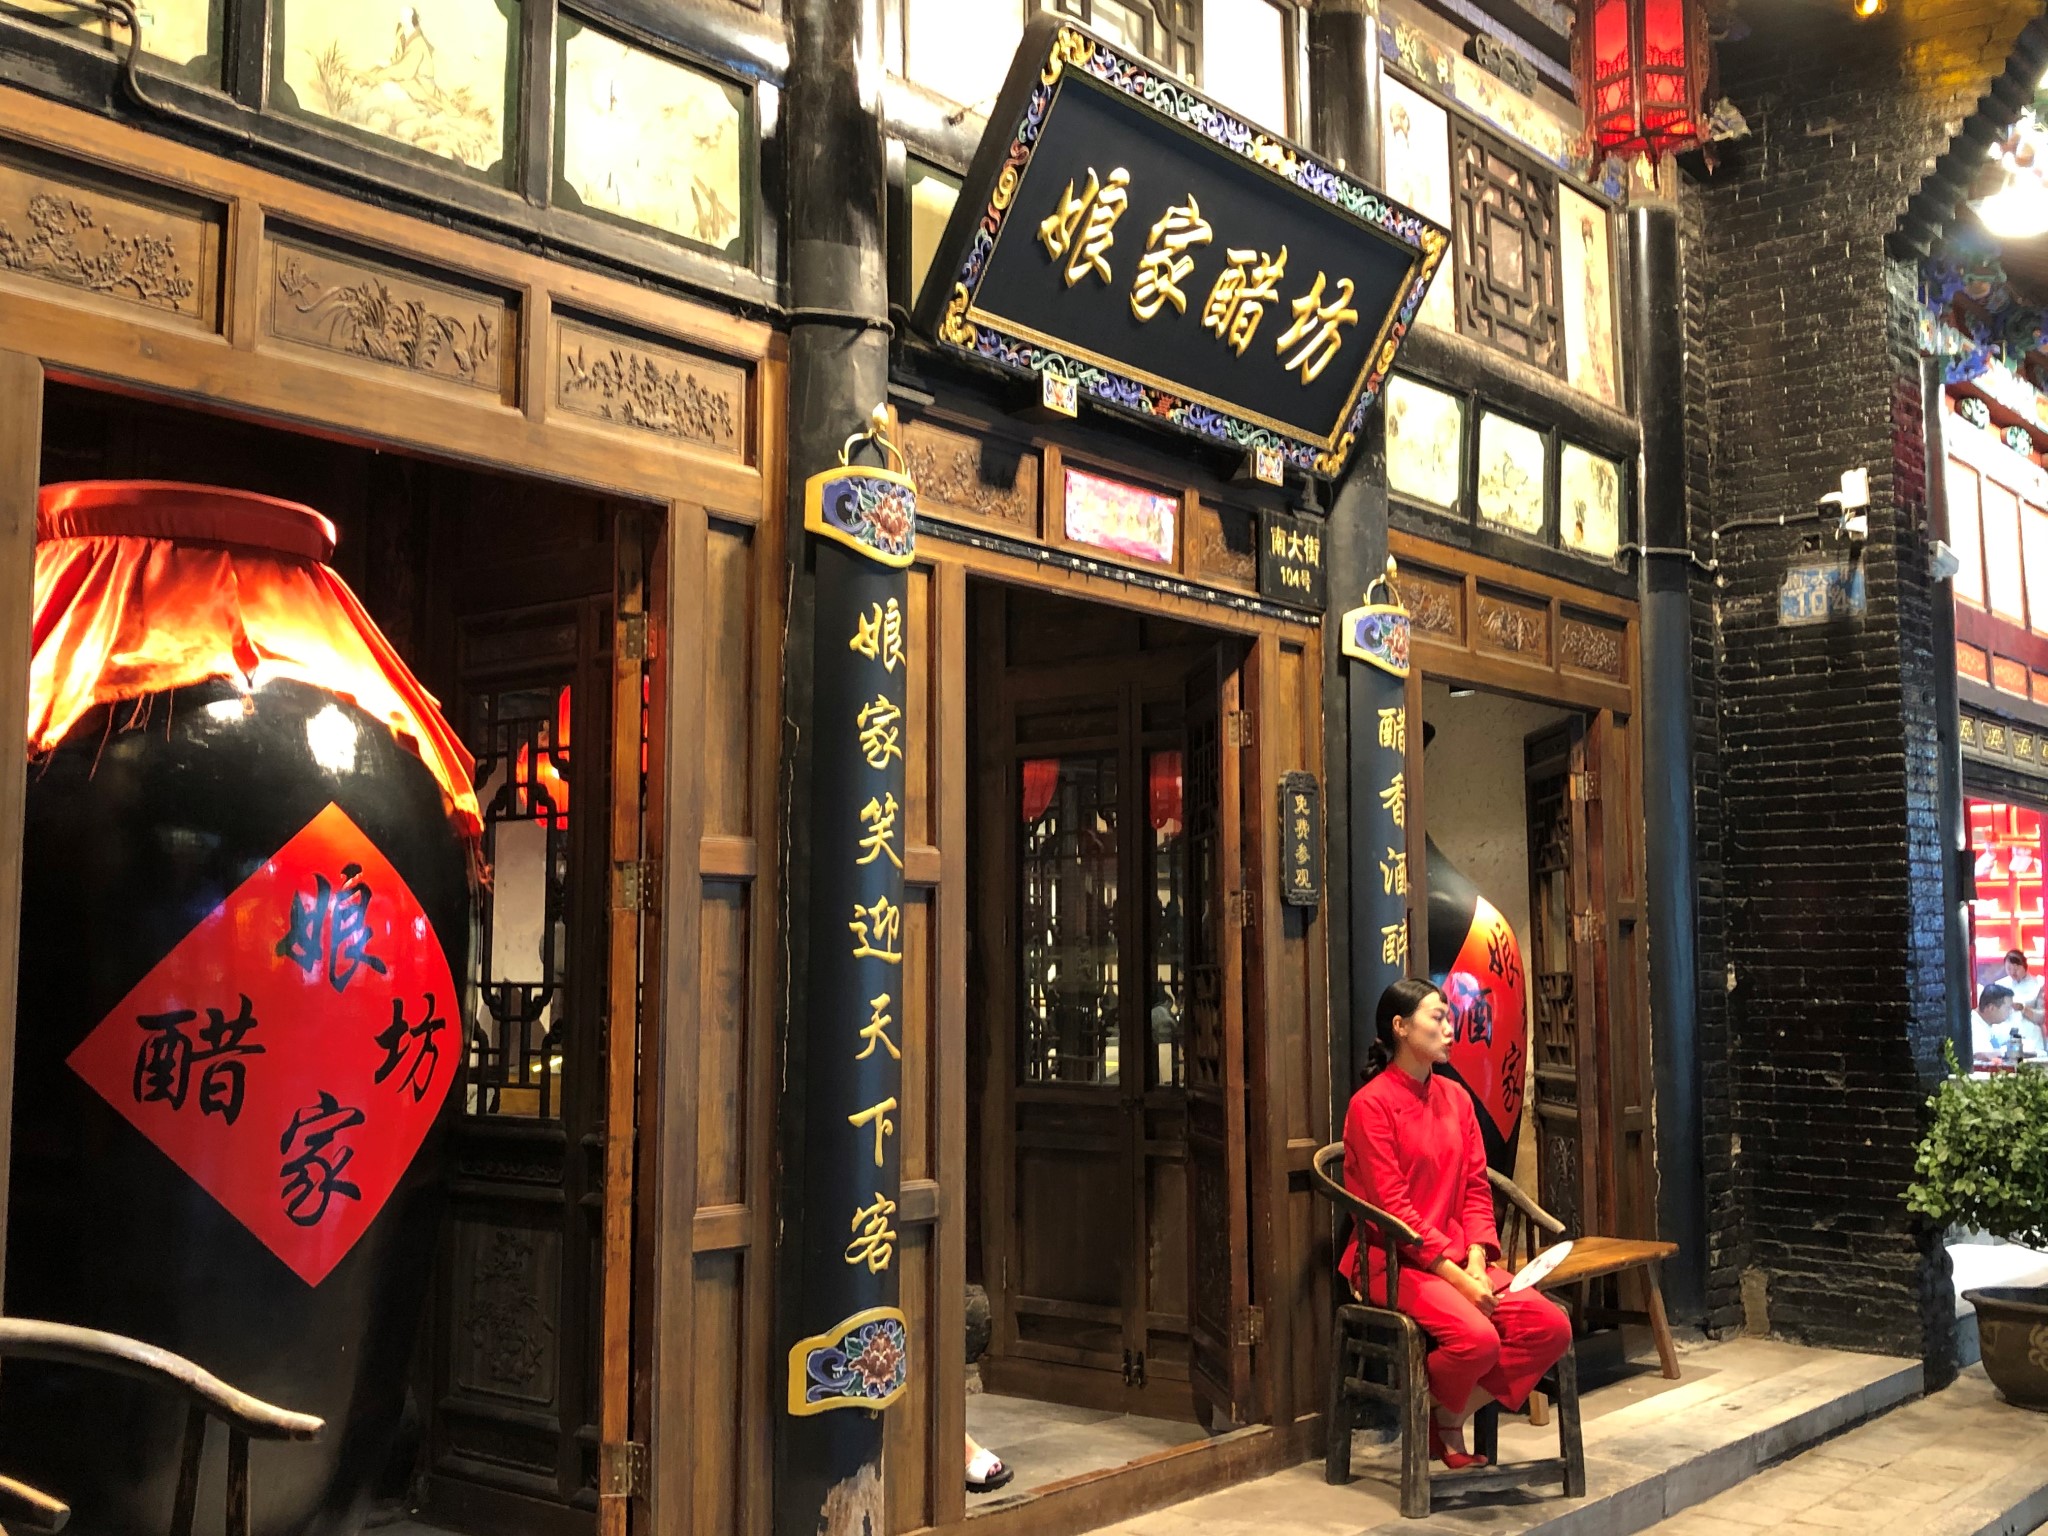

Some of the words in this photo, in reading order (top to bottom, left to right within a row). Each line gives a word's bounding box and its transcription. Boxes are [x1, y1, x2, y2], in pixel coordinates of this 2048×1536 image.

[1038, 167, 1358, 385] 娘家醋坊
[1270, 525, 1320, 568] 南大街
[1280, 566, 1311, 594] 104号
[276, 863, 387, 992] 娘
[844, 598, 906, 1274] 娘家笑迎天下客
[1487, 922, 1520, 989] 娘
[133, 993, 266, 1125] 醋
[374, 992, 446, 1102] 坊
[1450, 981, 1493, 1049] 酒
[1502, 1040, 1521, 1113] 家
[280, 1090, 366, 1226] 家
